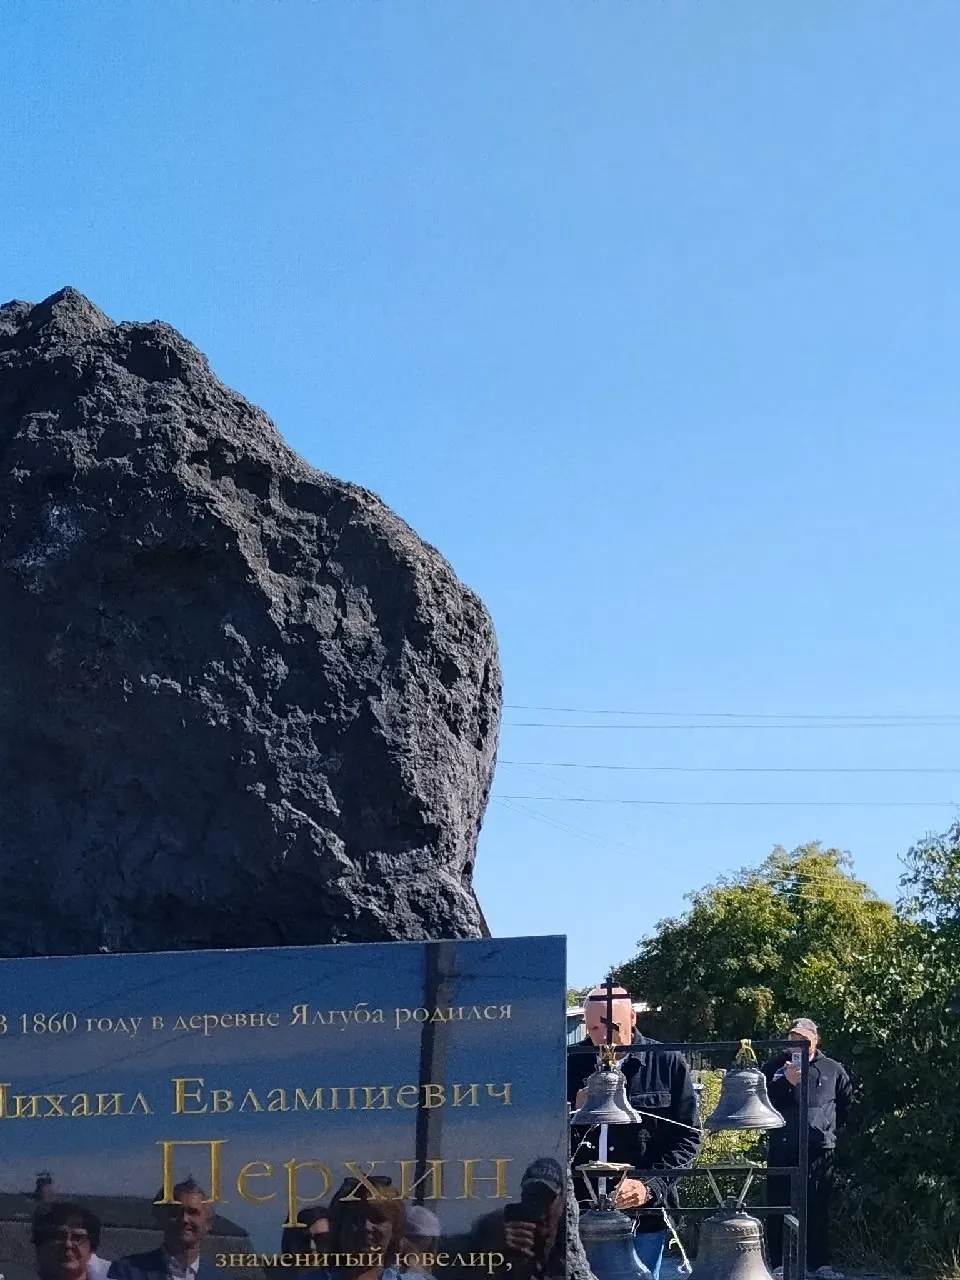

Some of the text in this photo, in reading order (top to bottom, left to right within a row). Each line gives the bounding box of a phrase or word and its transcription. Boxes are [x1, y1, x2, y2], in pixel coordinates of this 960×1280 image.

[20, 1012, 77, 1034] 1860
[86, 1017, 142, 1038] году
[152, 1016, 164, 1030] в
[173, 1012, 280, 1036] деревне
[291, 1003, 385, 1031] Ялгуба
[395, 1004, 512, 1030] родился
[171, 1077, 513, 1115] Евлампиевич
[153, 1139, 514, 1228] Перхин
[215, 1246, 513, 1274] знаменитый ювелир,
